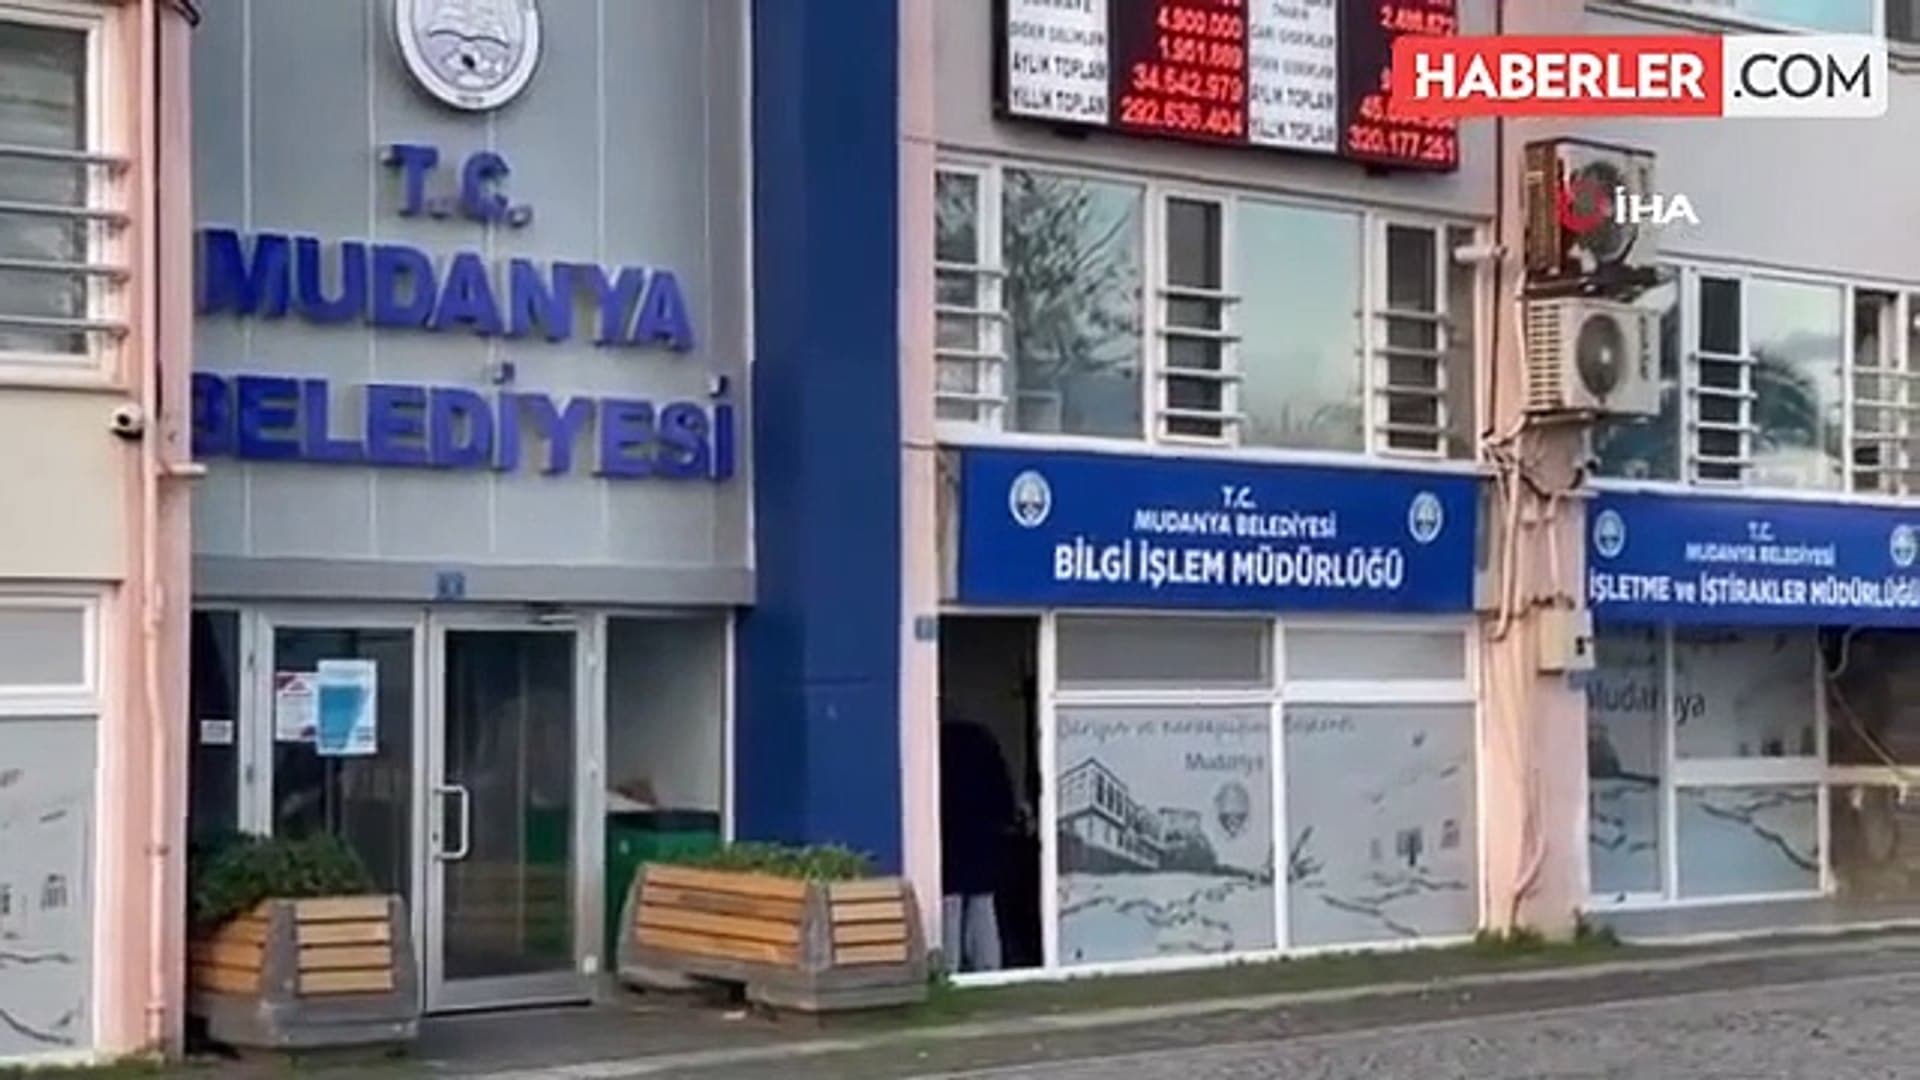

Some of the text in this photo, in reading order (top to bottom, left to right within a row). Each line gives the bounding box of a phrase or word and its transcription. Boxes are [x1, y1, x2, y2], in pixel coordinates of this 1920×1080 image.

[383, 143, 533, 229] T.C.
[195, 228, 695, 351] MUDANYA
[191, 362, 736, 481] BELEDİYESİ
[1221, 485, 1257, 509] T.C.
[1134, 508, 1336, 539] MUDANYA BELEDİYESİ
[1054, 536, 1404, 589] BİLGİ İŞLEM MÜDÜRLÜĞÜ
[1685, 542, 1757, 563] MUDANYA
[1590, 566, 1671, 603] İŞLETME
[1674, 580, 1696, 602] ve
[1701, 570, 1807, 606] İŞTİRAKLER
